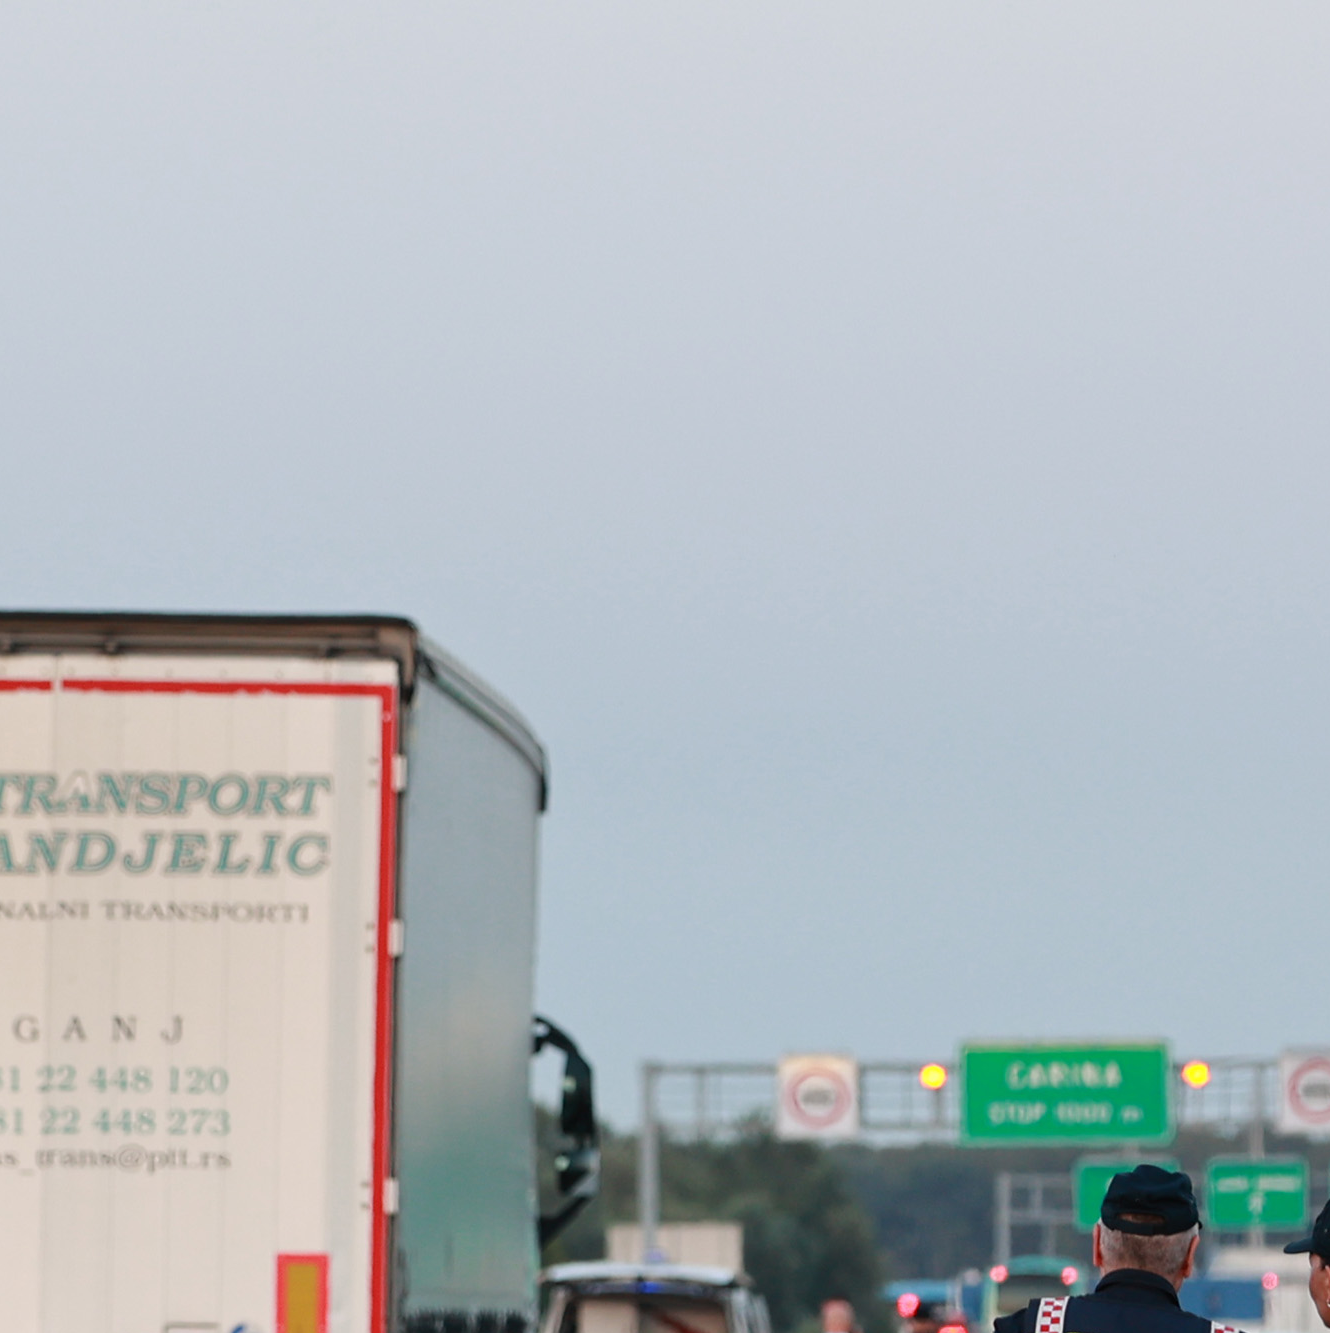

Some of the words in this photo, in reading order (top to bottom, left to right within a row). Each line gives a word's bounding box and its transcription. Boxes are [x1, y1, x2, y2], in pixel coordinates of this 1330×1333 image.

[101, 900, 310, 924] TRANSPORTI
[35, 1065, 78, 1094] 22
[88, 1066, 153, 1094] 448
[169, 1066, 230, 1095] 120
[1005, 1060, 1122, 1090] CARINA
[39, 1106, 81, 1135] 22
[90, 1107, 156, 1135] 448
[166, 1108, 232, 1136] 273
